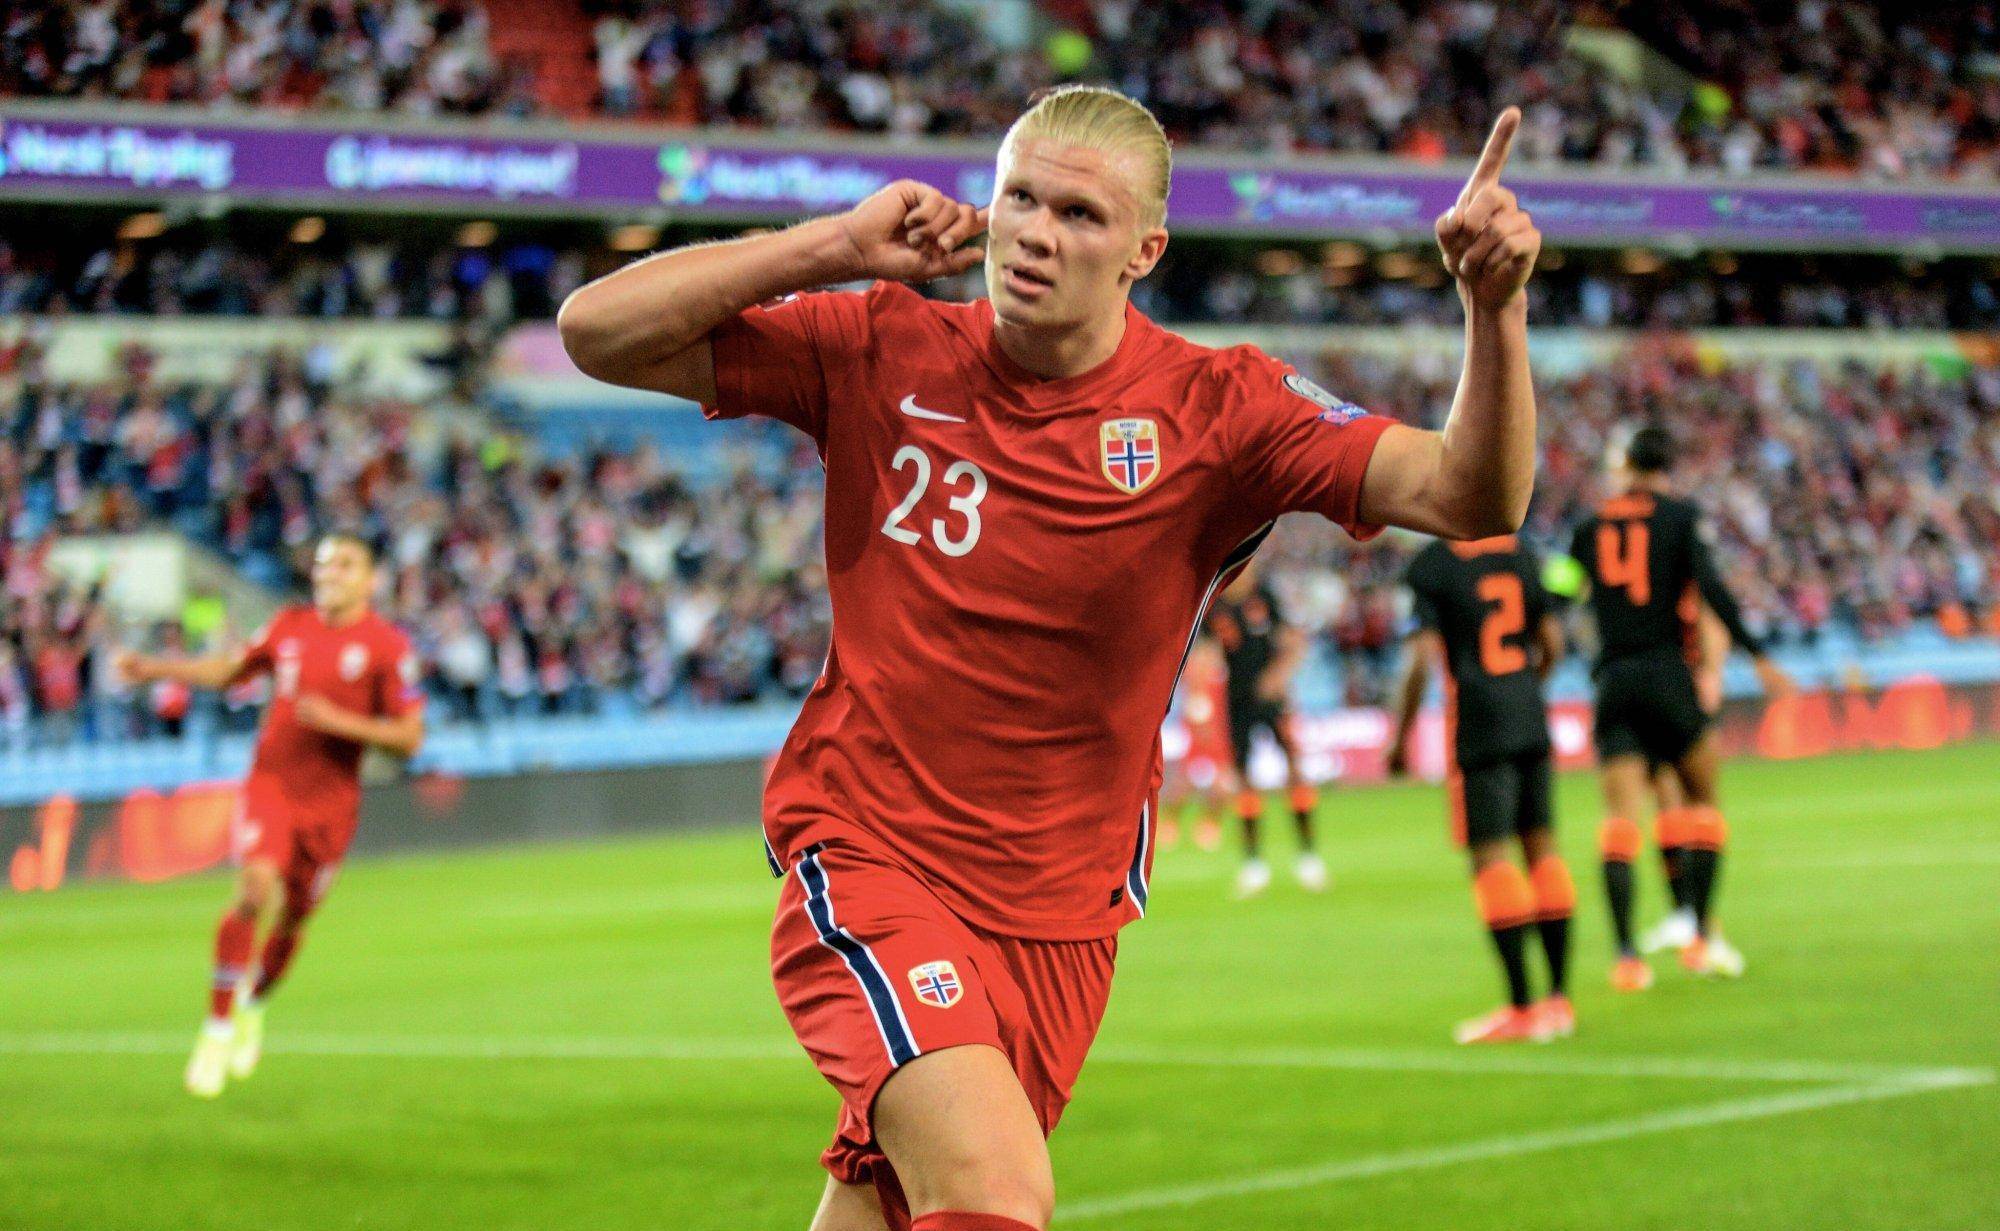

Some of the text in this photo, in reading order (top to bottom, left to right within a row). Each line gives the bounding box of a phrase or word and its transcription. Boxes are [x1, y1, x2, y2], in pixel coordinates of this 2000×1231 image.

[881, 446, 987, 556] 23
[1598, 521, 1650, 605] 4
[1478, 573, 1527, 676] 2
